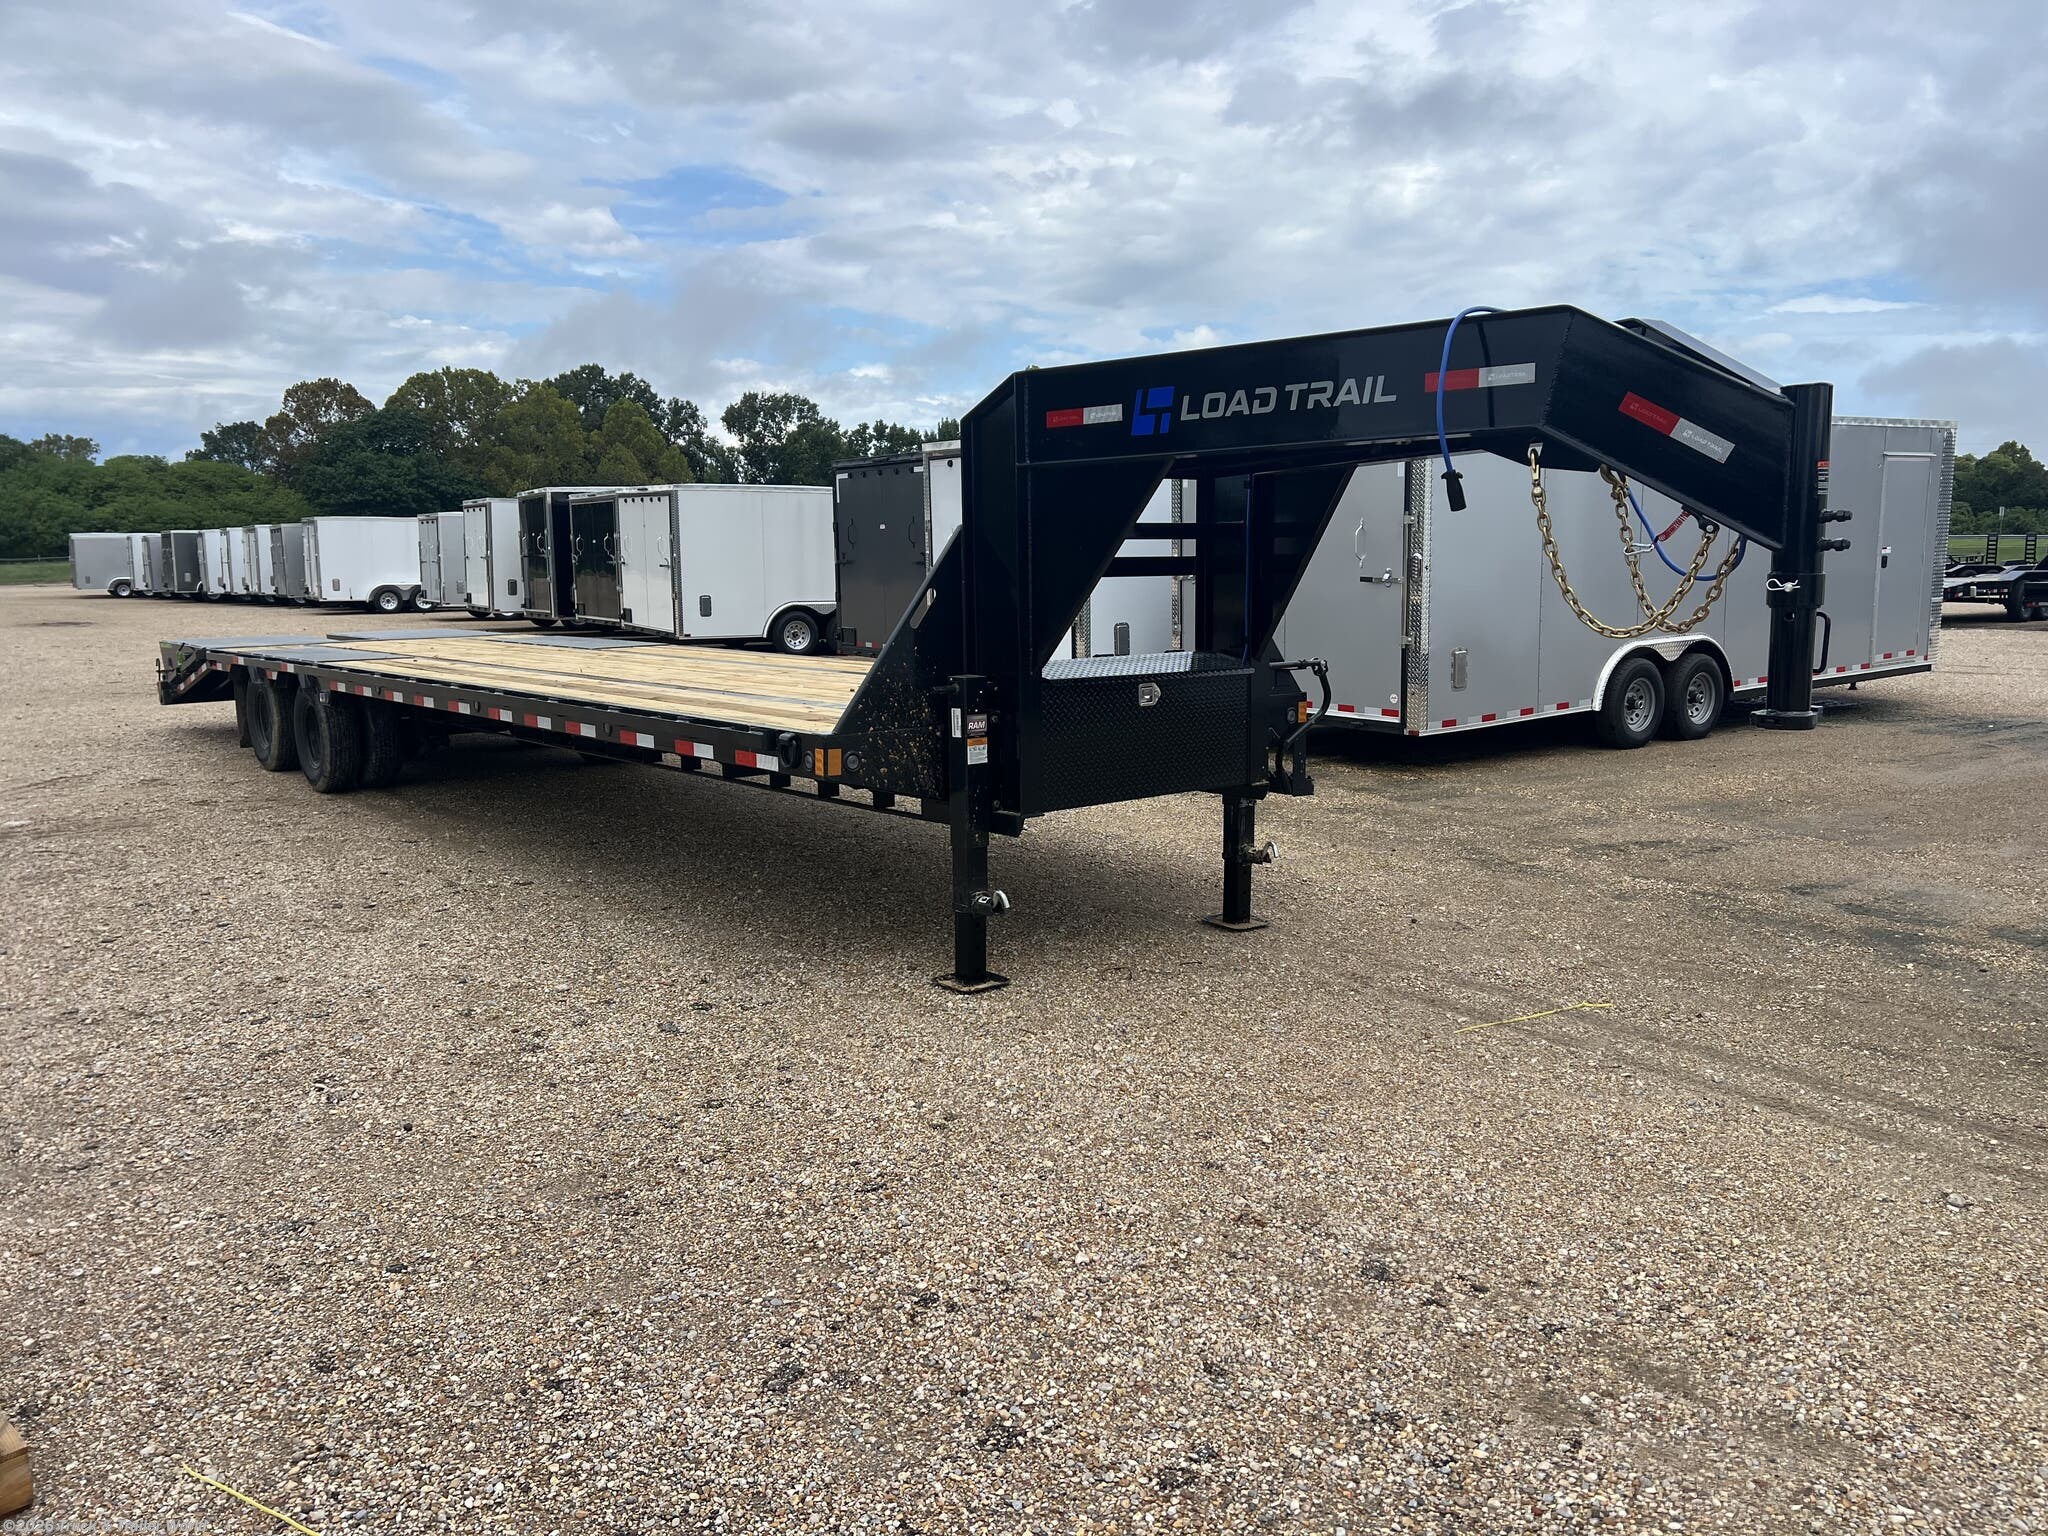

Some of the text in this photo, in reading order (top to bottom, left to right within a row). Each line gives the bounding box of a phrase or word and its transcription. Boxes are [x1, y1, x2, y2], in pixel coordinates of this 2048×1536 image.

[1180, 375, 1397, 421] LOAD TRAIL
[968, 721, 986, 730] RAM
